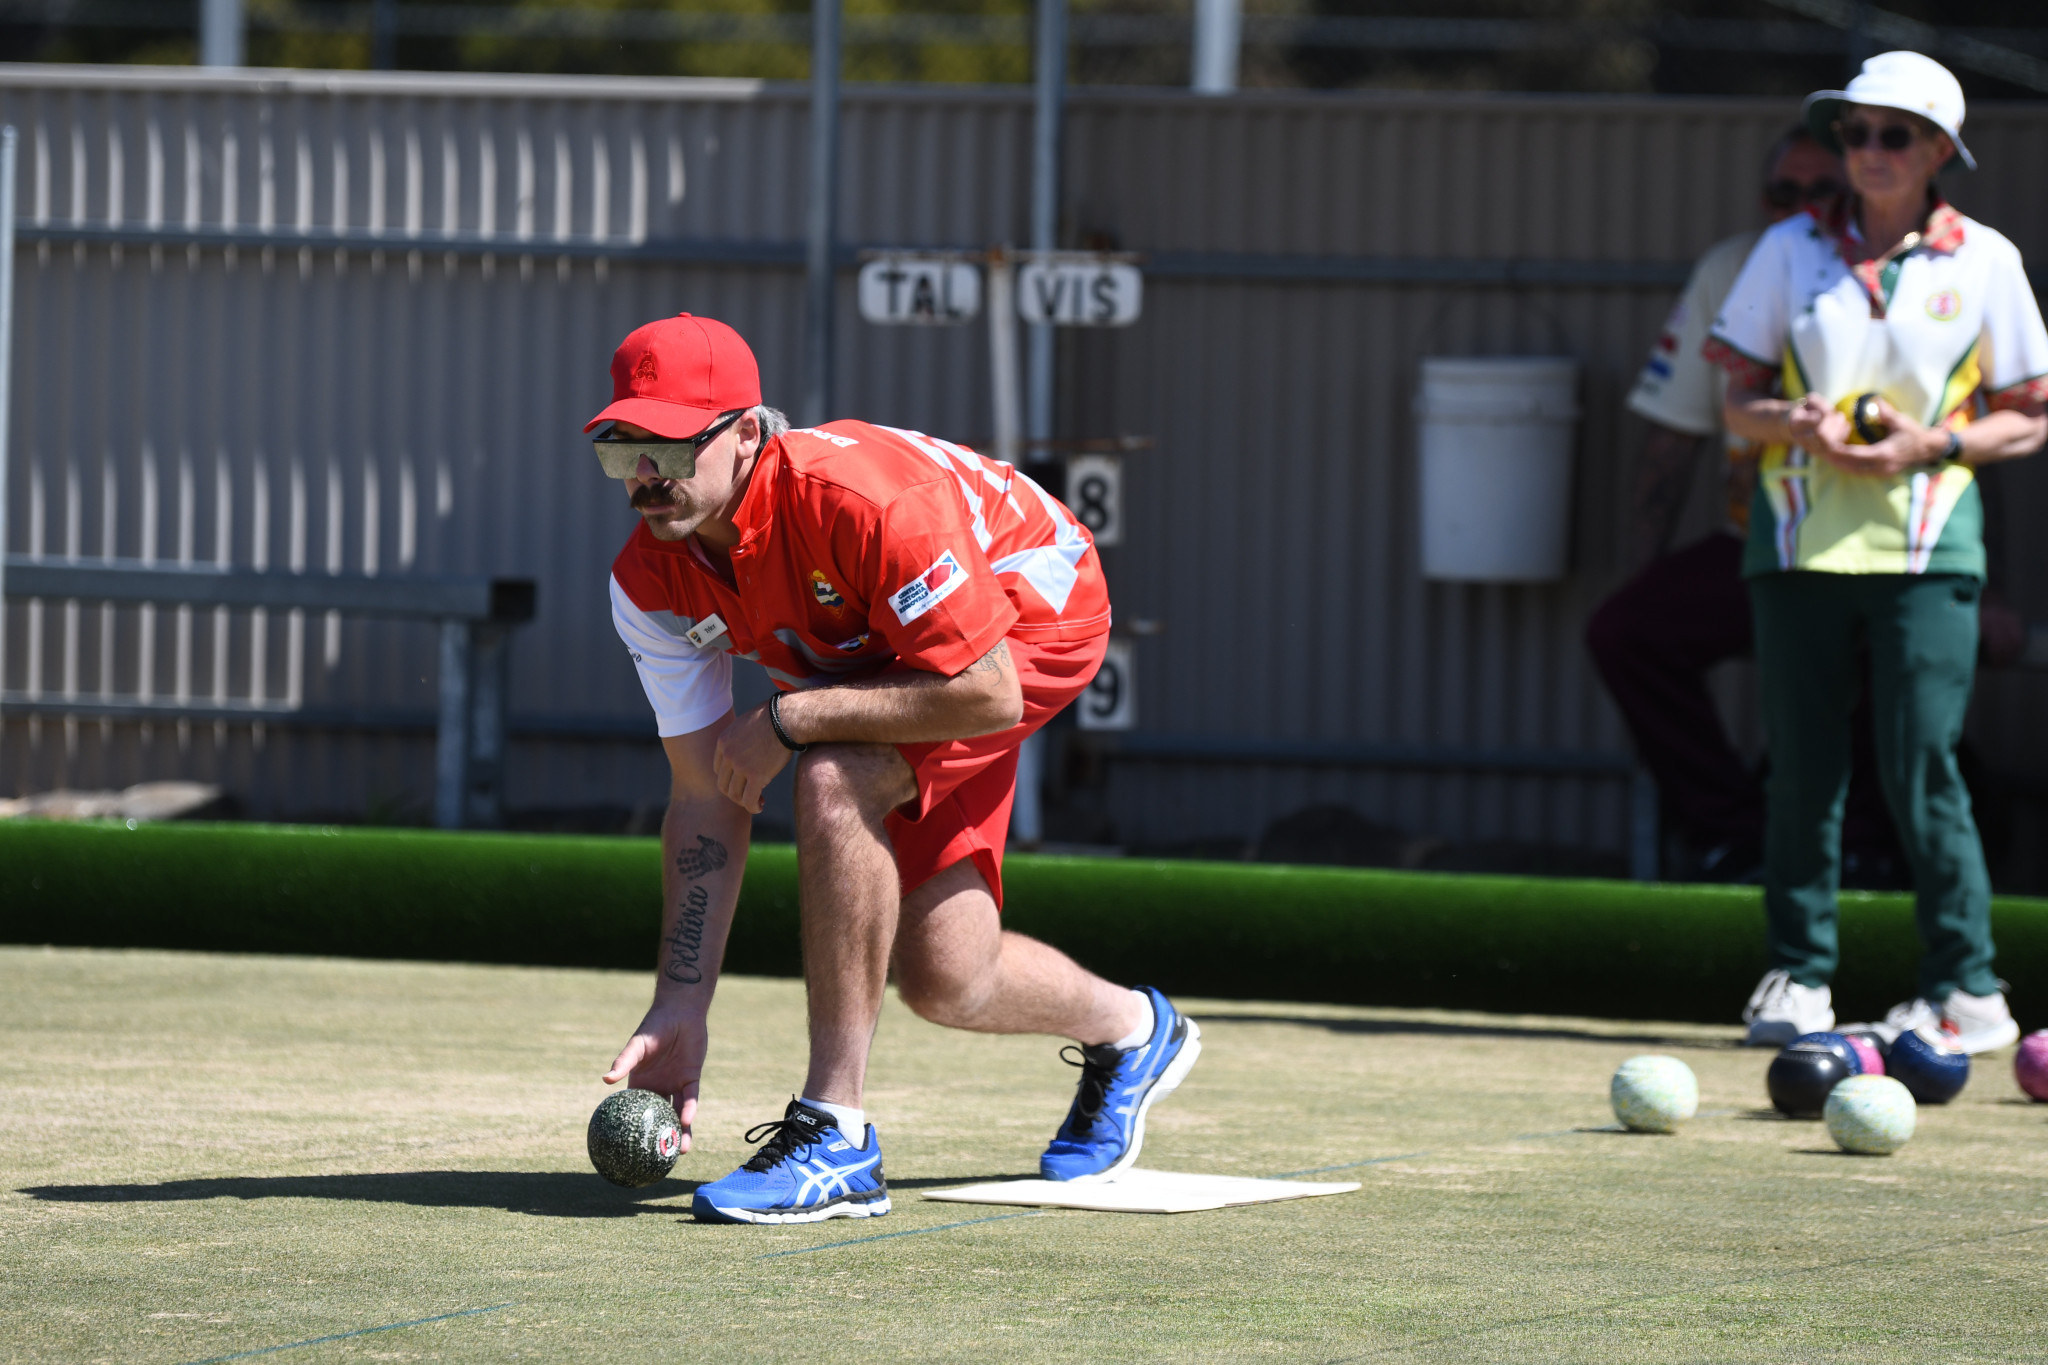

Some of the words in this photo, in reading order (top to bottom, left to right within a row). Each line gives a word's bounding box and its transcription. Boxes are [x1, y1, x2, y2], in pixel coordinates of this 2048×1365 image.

[875, 270, 962, 317] TAL
[1034, 272, 1119, 319] VIS
[1079, 476, 1109, 533] 8
[898, 581, 923, 600] CENTRAL
[898, 587, 927, 606] VICTORIA
[898, 591, 929, 614] REMOVALS
[1090, 661, 1120, 718] 9
